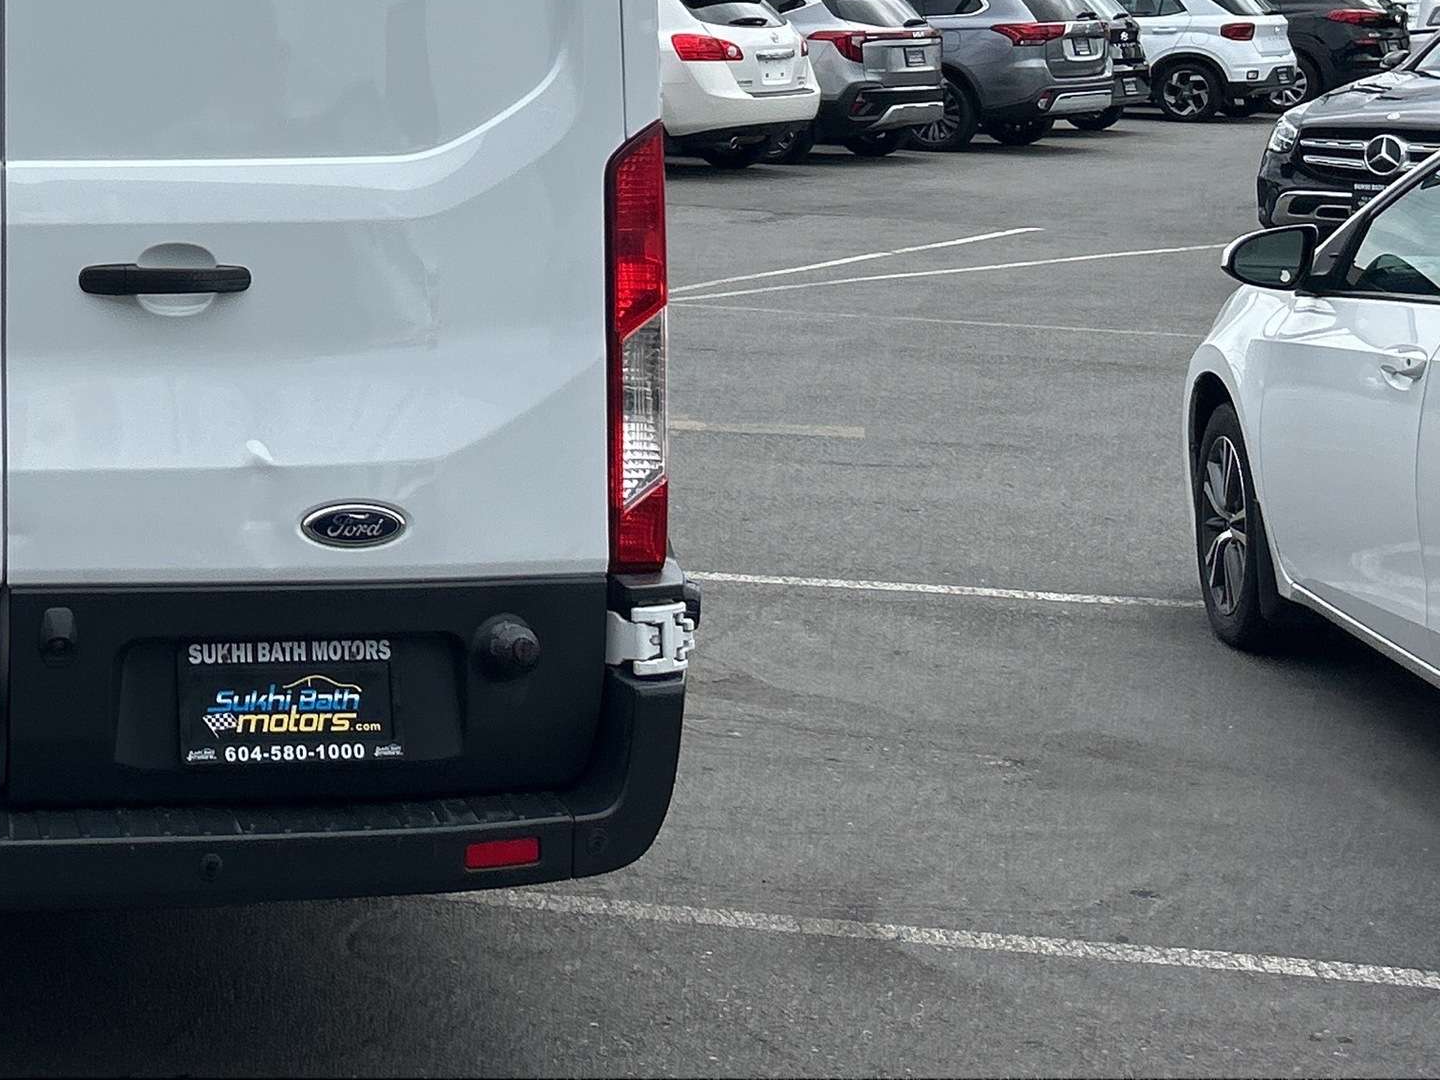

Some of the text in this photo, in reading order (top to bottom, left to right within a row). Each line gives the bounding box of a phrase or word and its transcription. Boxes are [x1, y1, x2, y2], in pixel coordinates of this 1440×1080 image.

[327, 513, 384, 537] Ford
[188, 640, 392, 665] SUKHI BATH MOTORS
[208, 684, 361, 712] Sukhi Bath
[224, 743, 365, 762] 604-580-1000
